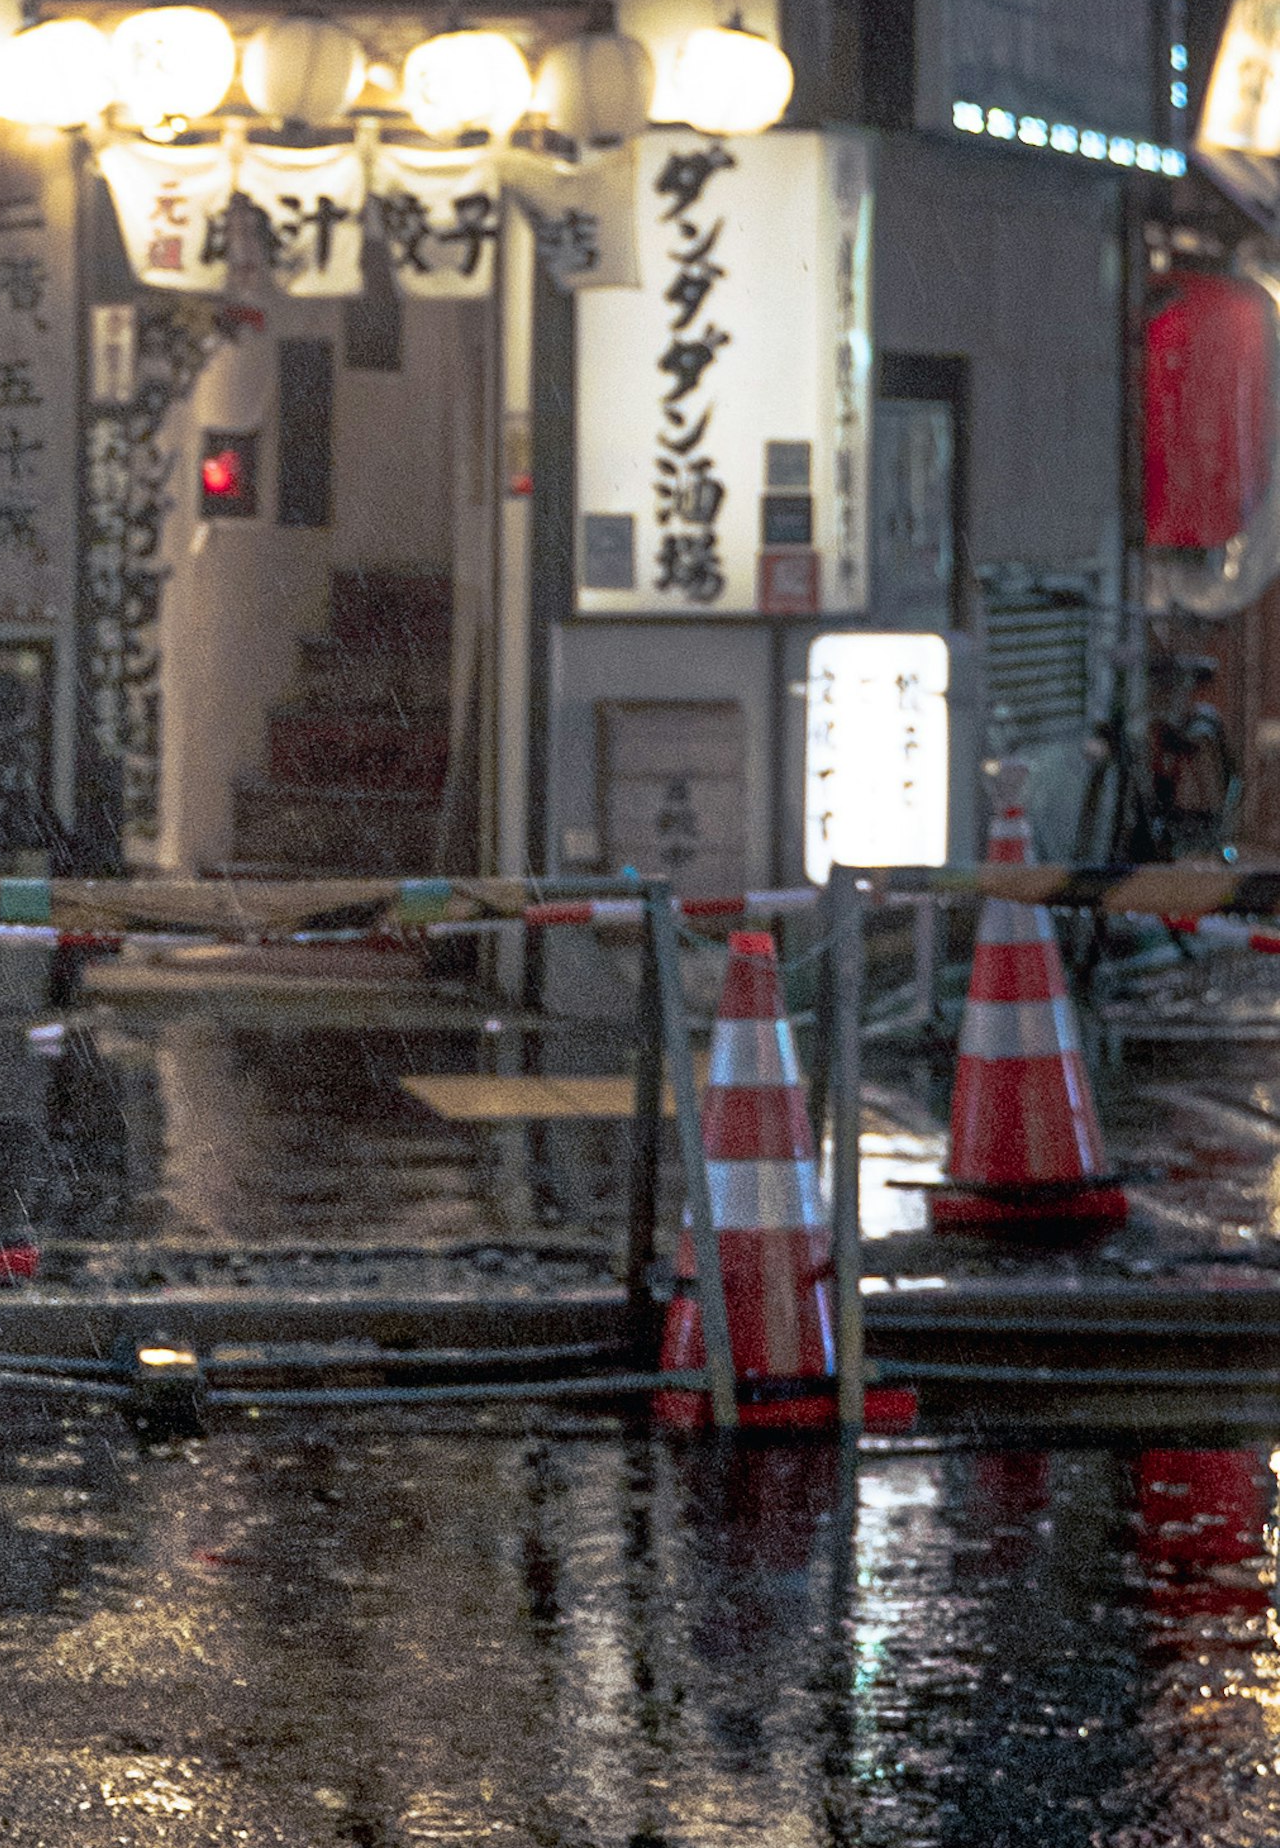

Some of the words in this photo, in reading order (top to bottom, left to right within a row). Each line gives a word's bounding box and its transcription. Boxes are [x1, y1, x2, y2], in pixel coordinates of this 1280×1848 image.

[653, 143, 737, 604] ダンダダン酒場
